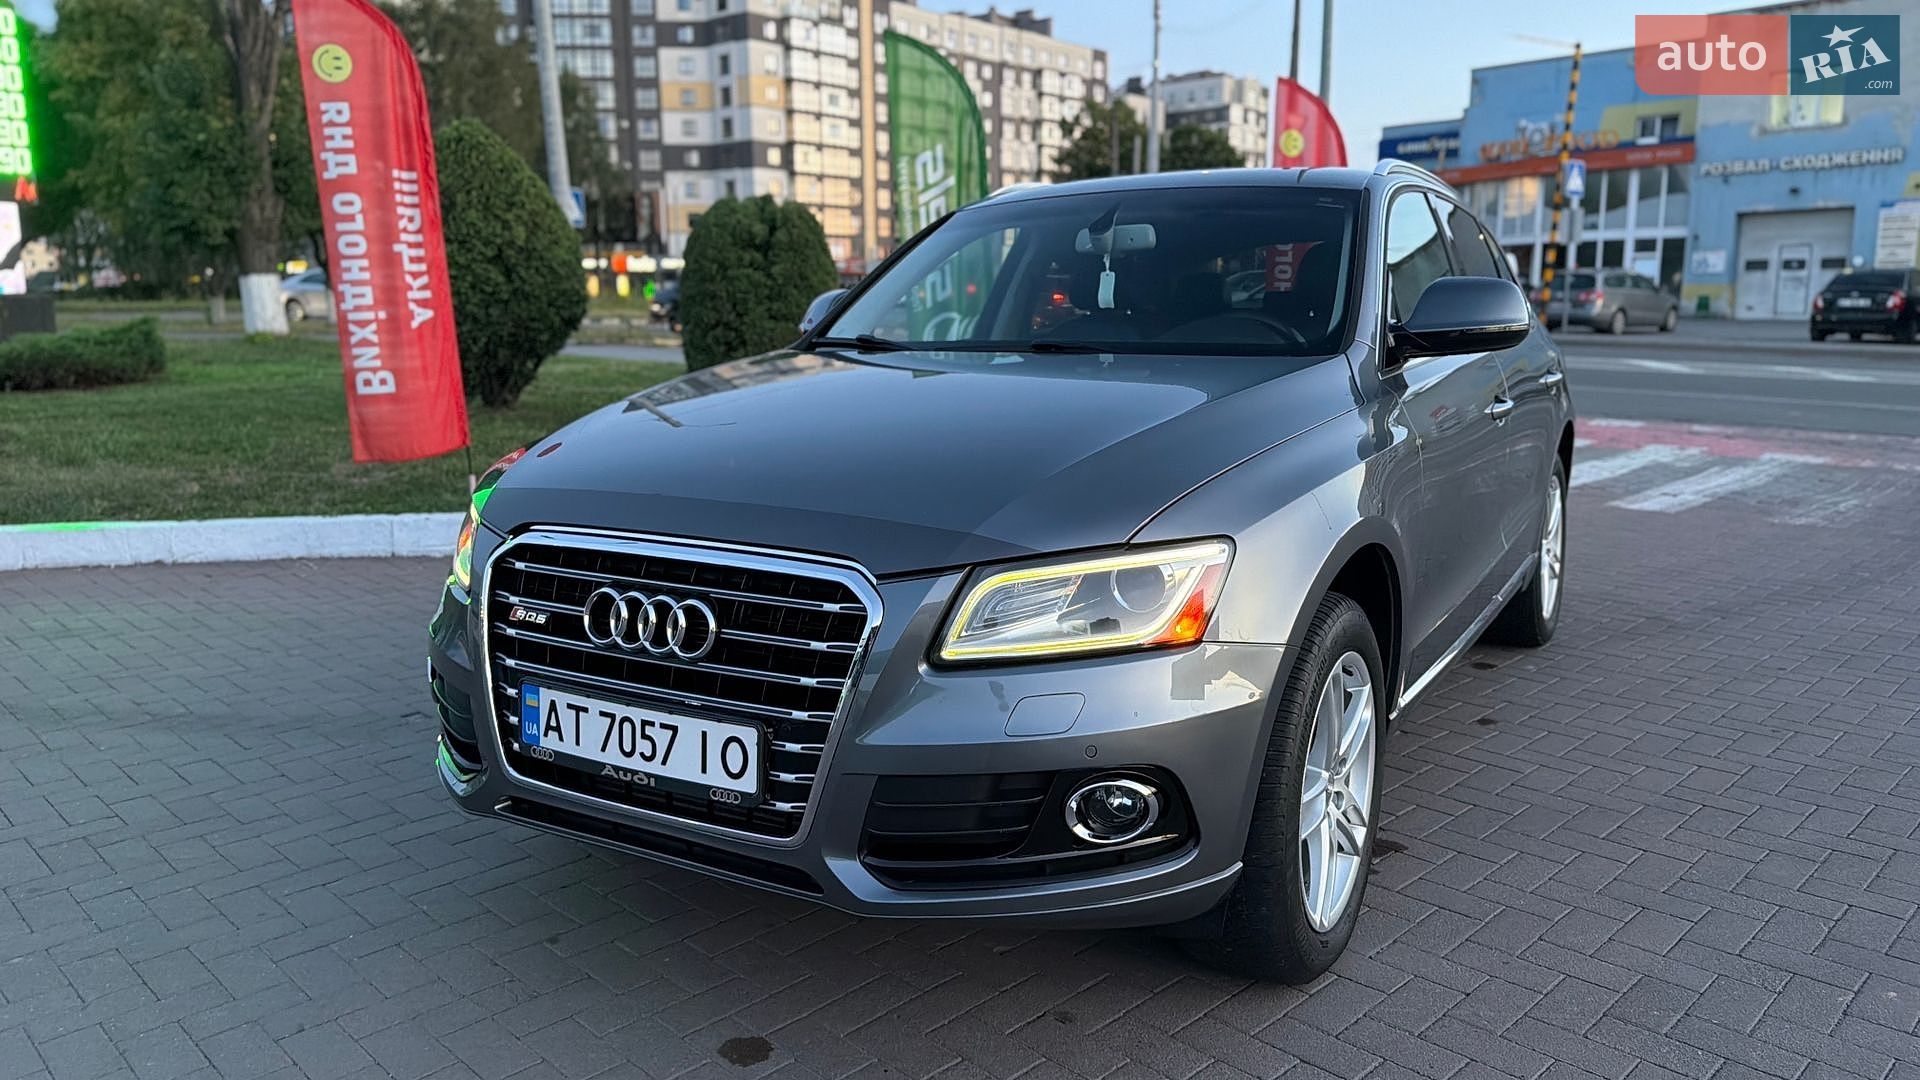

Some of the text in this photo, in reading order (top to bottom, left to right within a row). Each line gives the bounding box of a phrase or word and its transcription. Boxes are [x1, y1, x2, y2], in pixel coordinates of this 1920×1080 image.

[525, 720, 539, 737] UA
[543, 699, 749, 780] AT 7057 IO
[601, 764, 656, 787] Audi
